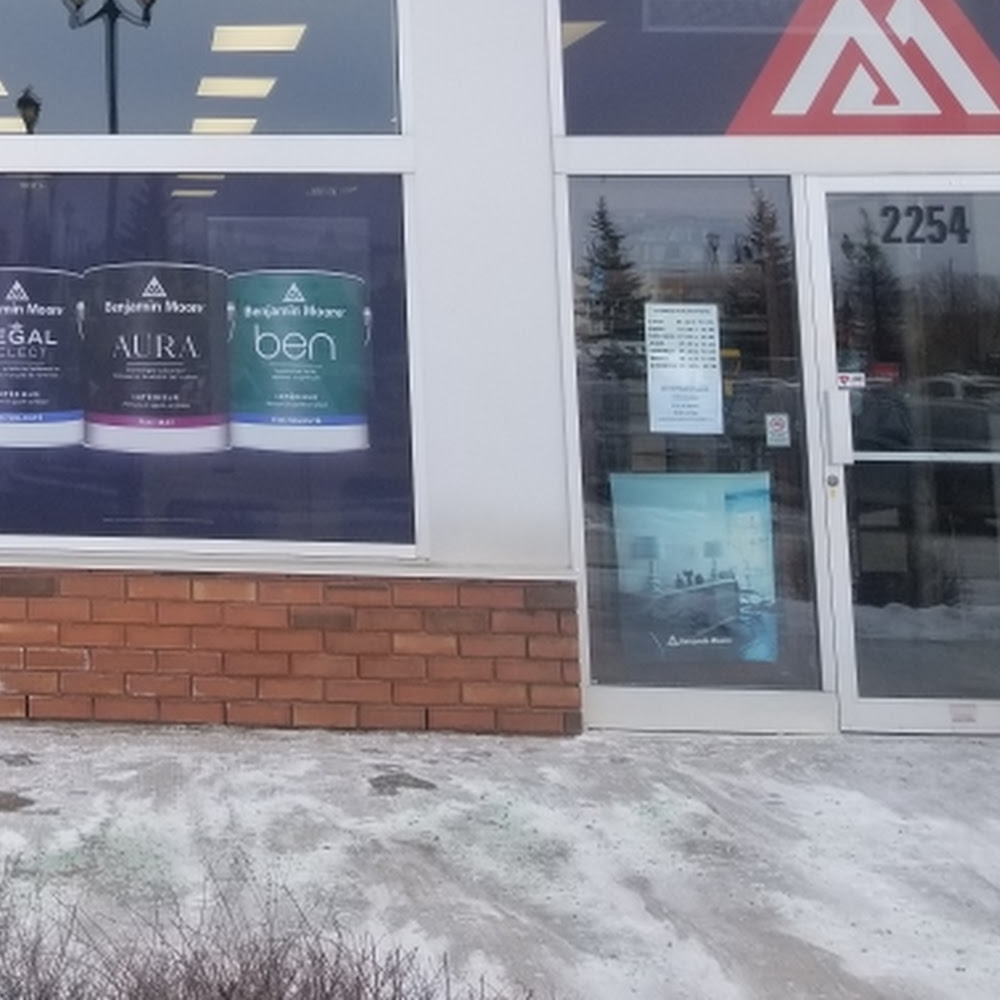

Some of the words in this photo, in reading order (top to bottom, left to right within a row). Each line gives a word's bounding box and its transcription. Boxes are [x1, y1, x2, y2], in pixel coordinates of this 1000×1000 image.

[880, 205, 971, 245] 2254
[104, 299, 163, 315] Benjamin
[112, 333, 201, 359] AURA
[254, 324, 337, 361] ben
